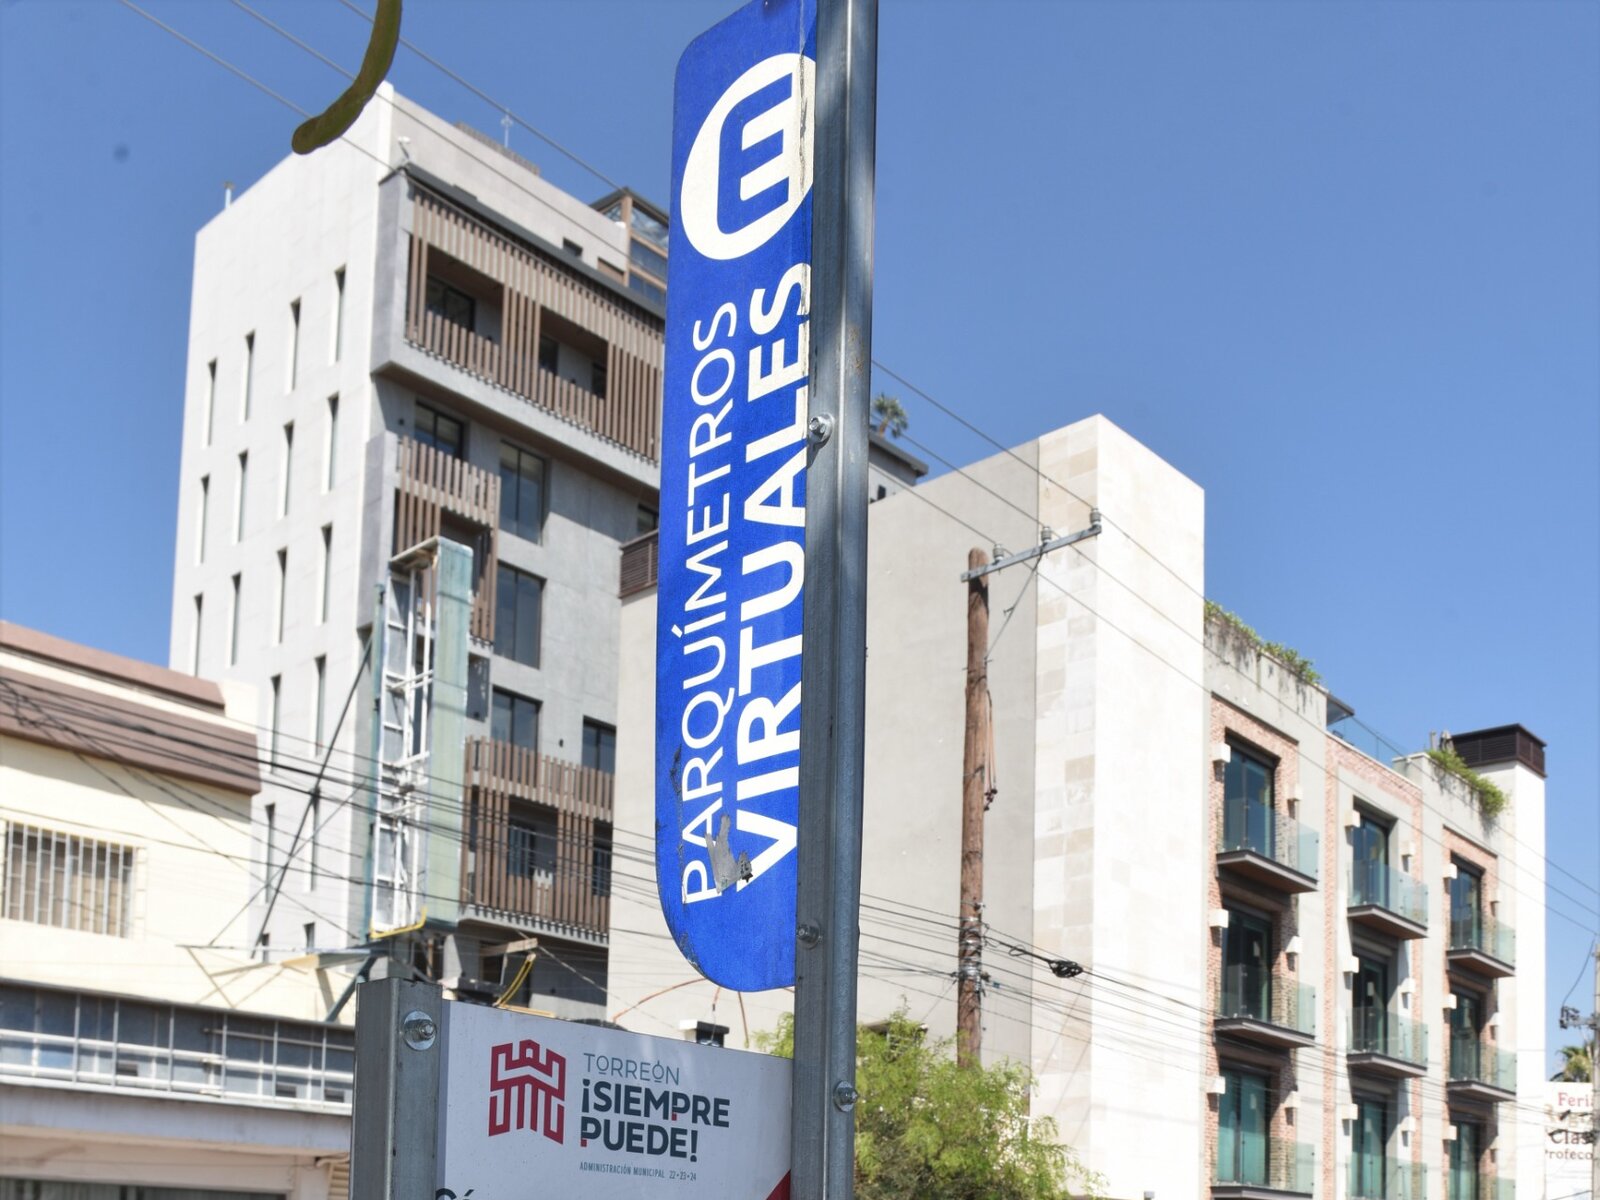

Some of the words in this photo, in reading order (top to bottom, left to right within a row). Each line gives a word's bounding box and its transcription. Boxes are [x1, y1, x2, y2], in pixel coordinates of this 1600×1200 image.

[736, 262, 812, 892] VIRTUALES
[671, 302, 737, 904] PARQUÍMETROS
[583, 1053, 680, 1086] TORREÓN
[581, 1078, 730, 1128] ¡SIEMPRE
[1558, 1091, 1594, 1107] Feri
[580, 1116, 698, 1162] PUEDE!
[579, 1161, 632, 1175] ADMINISTRACIÓN
[633, 1166, 665, 1178] MUNICIPAL
